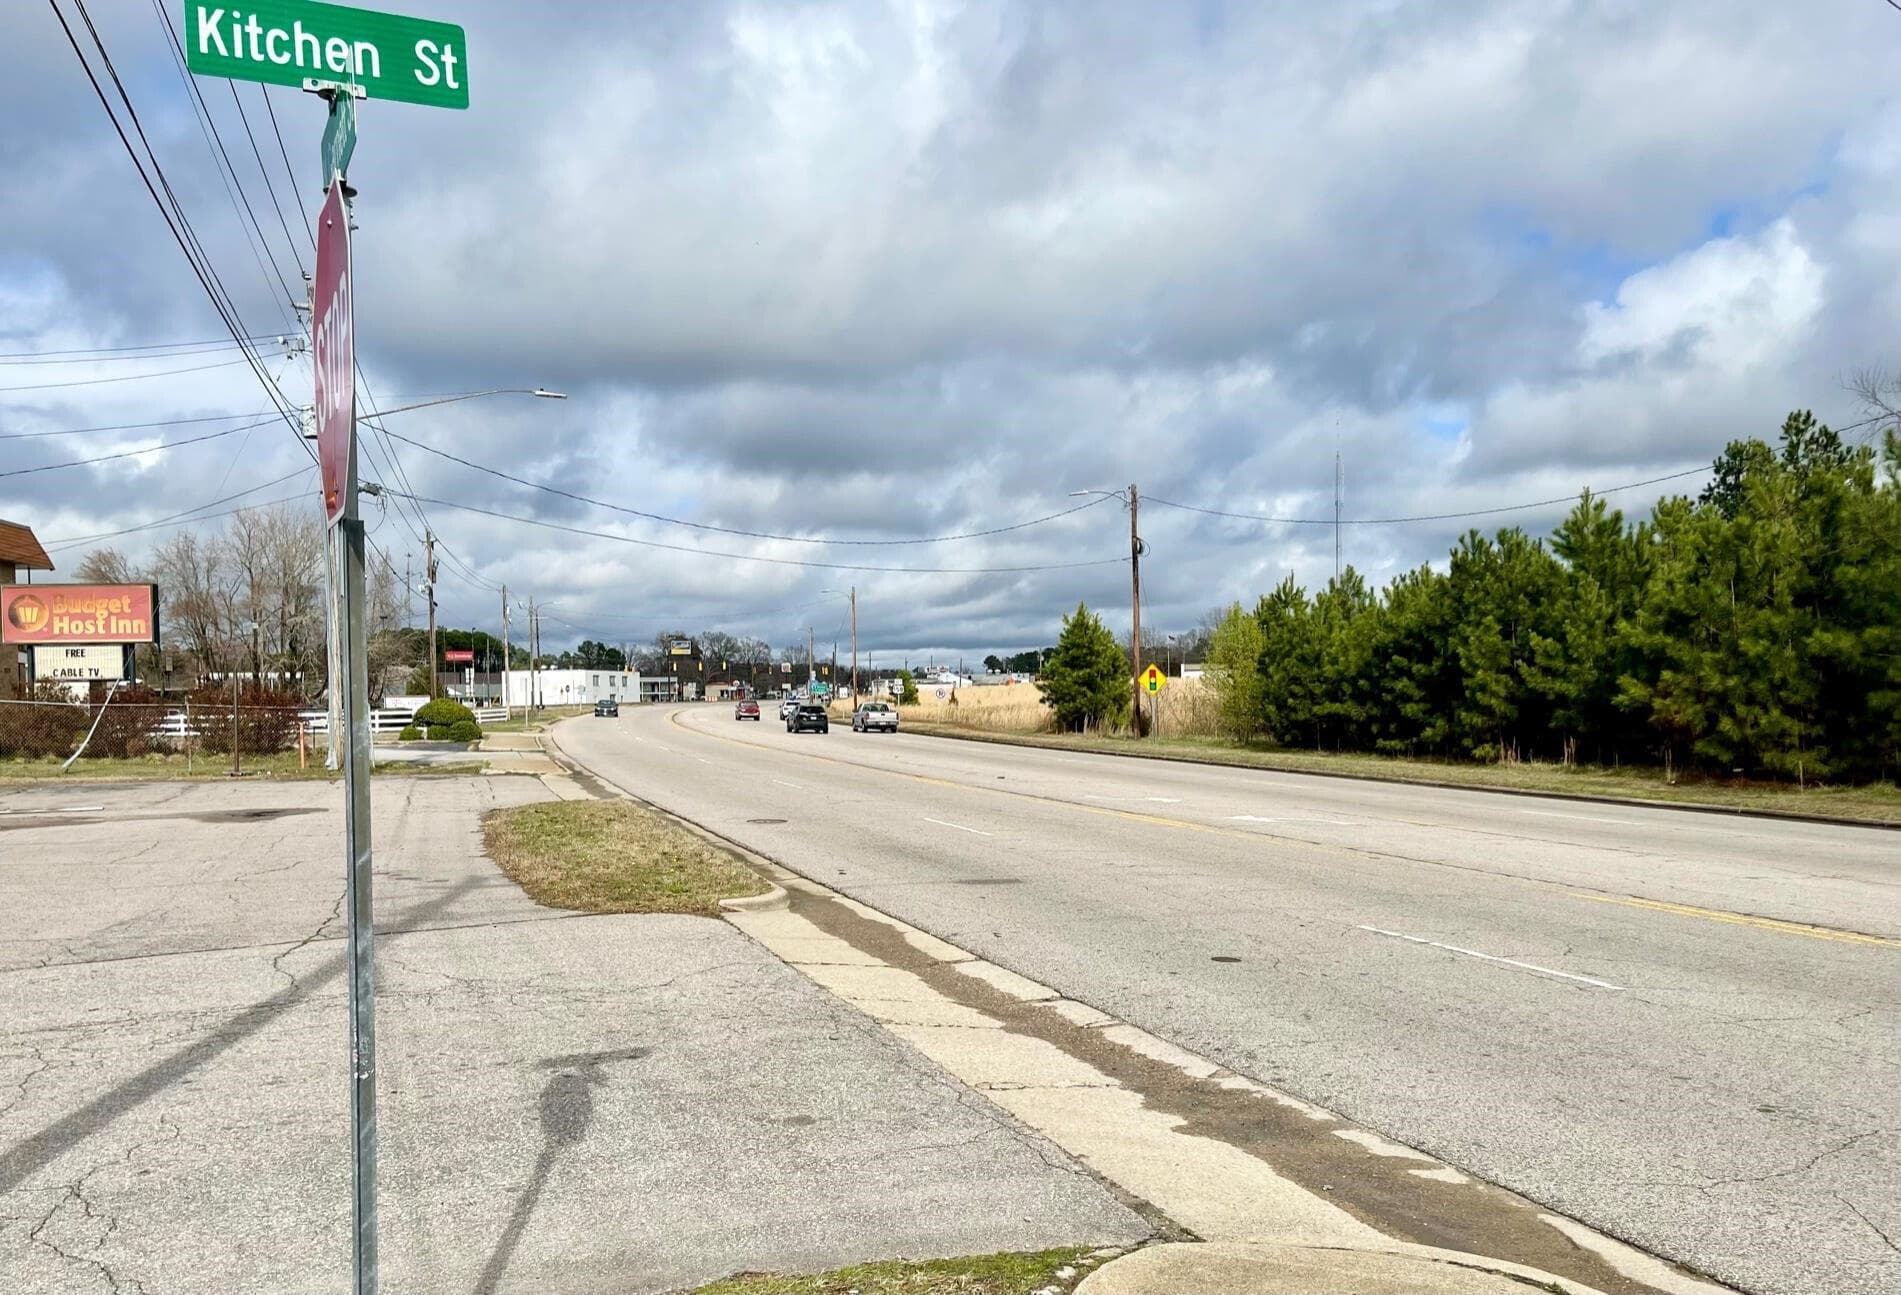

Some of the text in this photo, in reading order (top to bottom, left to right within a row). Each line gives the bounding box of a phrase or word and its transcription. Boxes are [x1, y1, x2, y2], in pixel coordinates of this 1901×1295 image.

[197, 6, 459, 89] Kitchen St
[317, 270, 348, 433] STOP
[52, 592, 132, 619] Budget
[53, 615, 147, 635] Host Inn
[65, 648, 86, 658] FREE
[52, 668, 100, 677] CABLE TV
